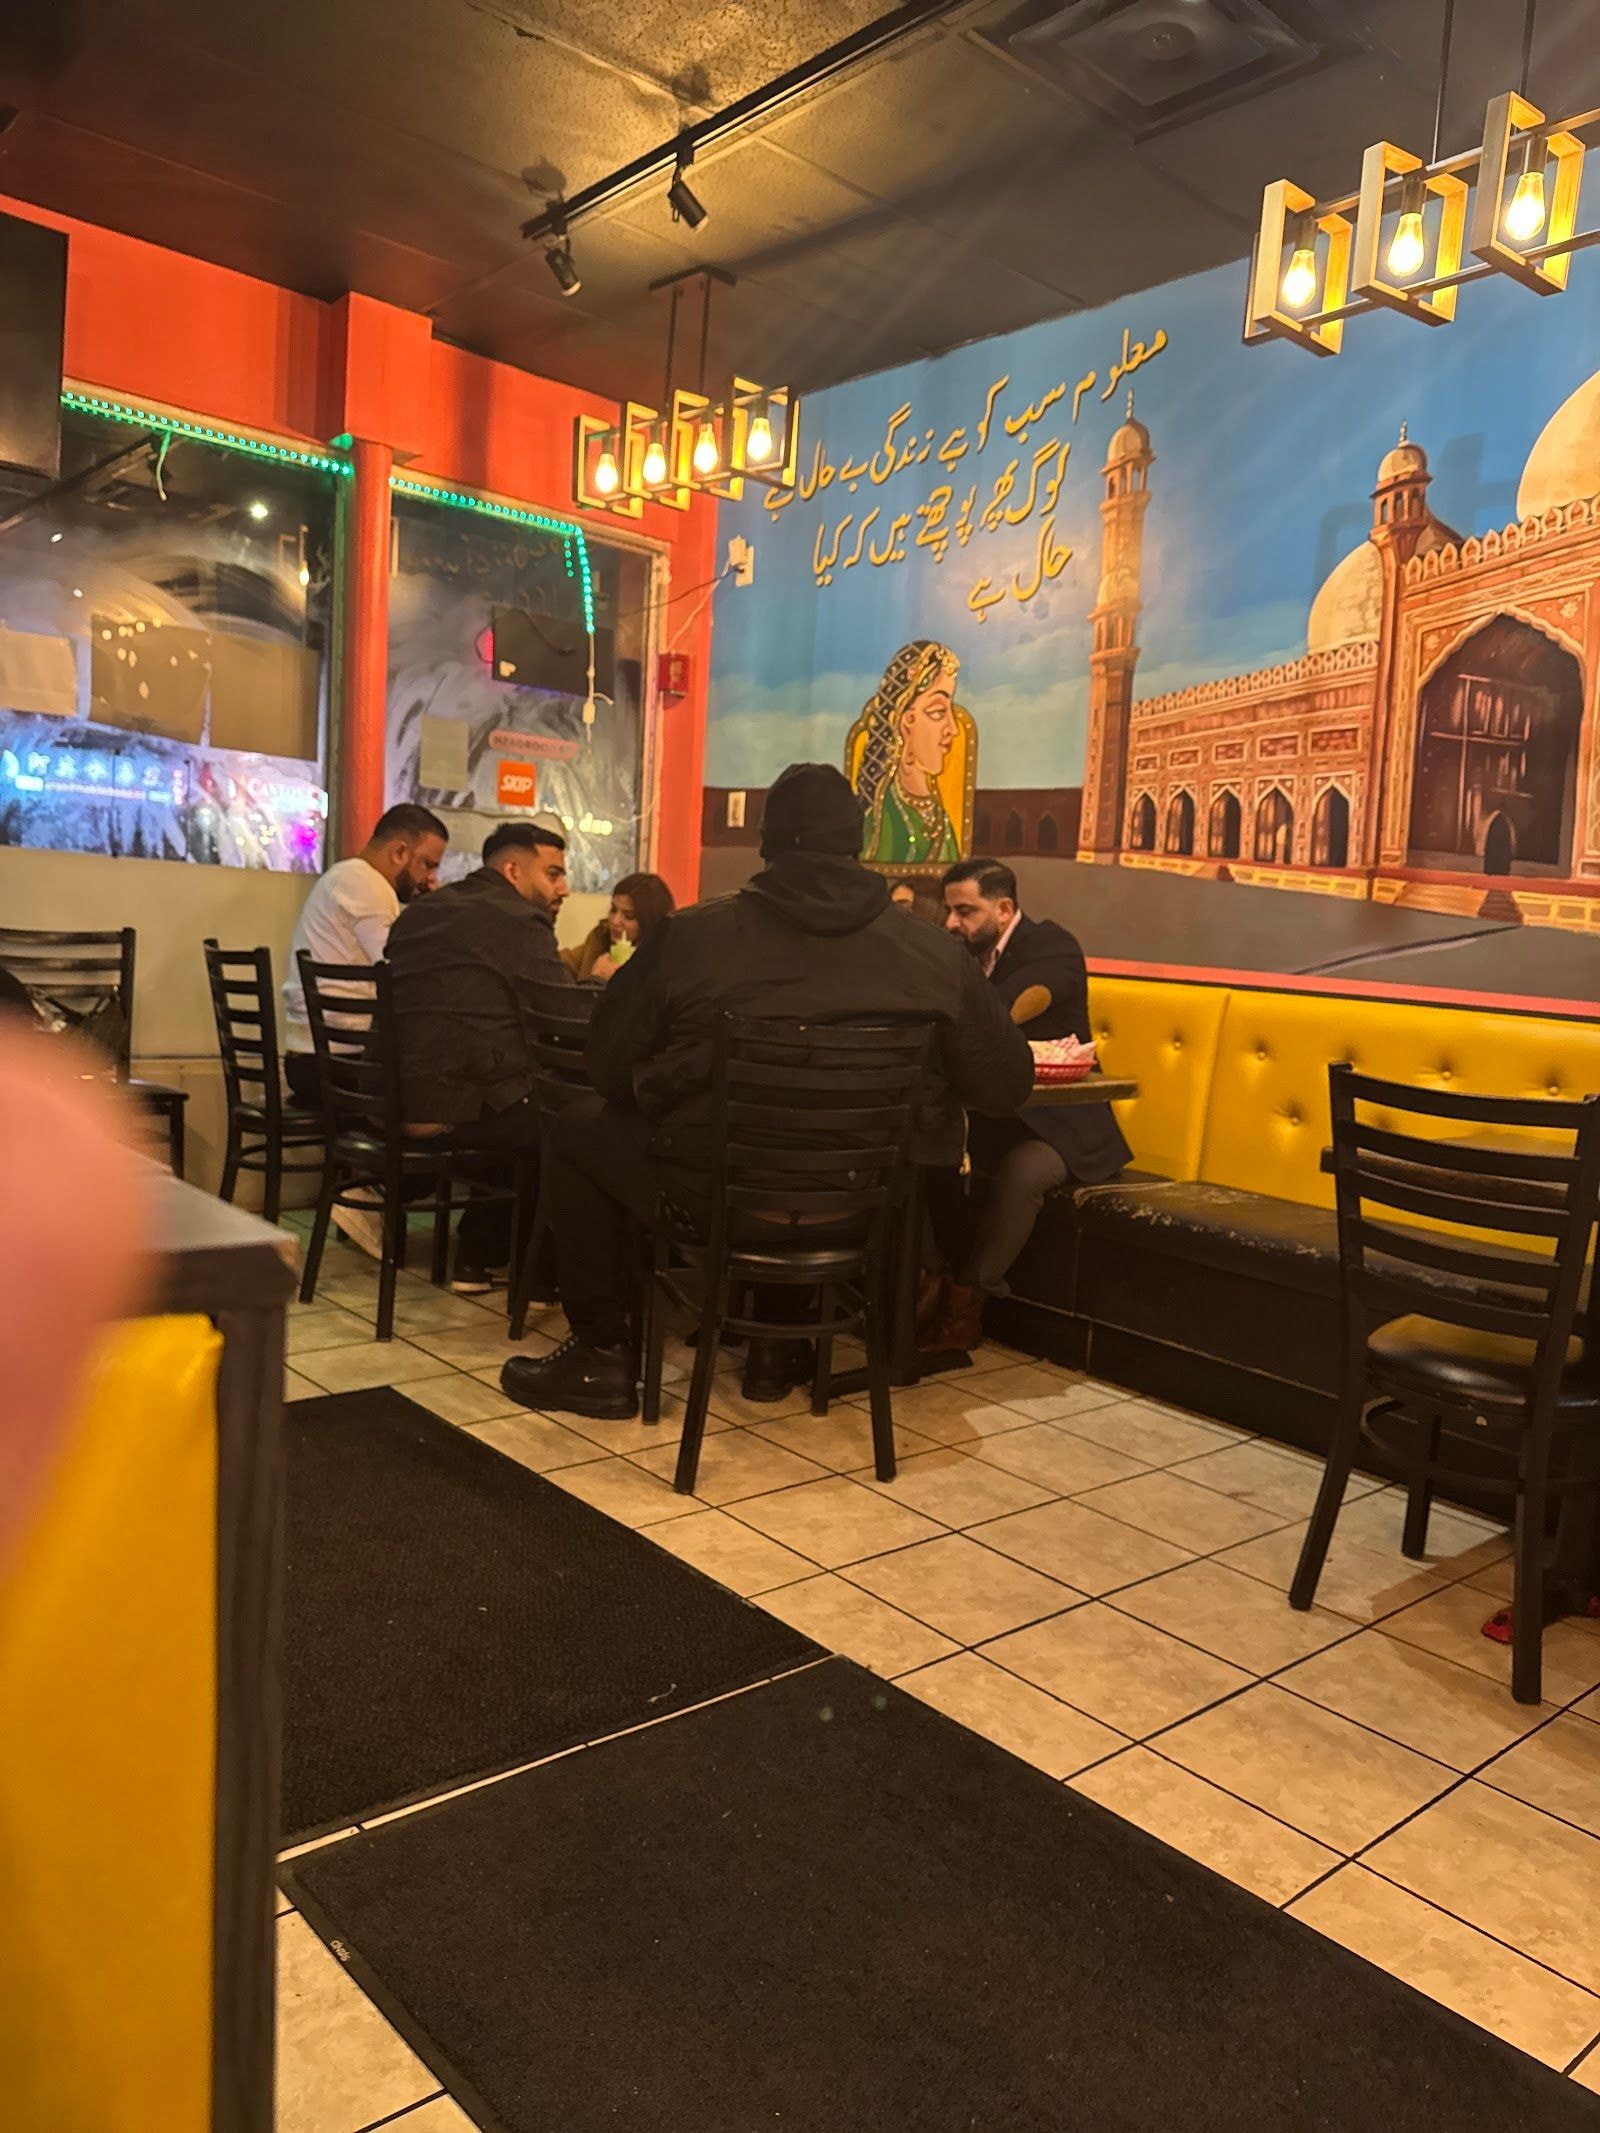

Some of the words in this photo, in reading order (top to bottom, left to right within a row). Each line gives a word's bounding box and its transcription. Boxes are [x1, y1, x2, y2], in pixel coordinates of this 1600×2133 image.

[1072, 327, 1168, 424] معلوم
[870, 402, 935, 485] زندگی
[938, 427, 969, 473] ہے
[977, 375, 1009, 454] کو
[1005, 382, 1066, 444] سب
[799, 440, 836, 501] حال
[979, 458, 1020, 533] پھر
[1004, 437, 1071, 525] لوگ
[813, 513, 853, 587] کیا
[843, 506, 881, 569] کہ
[869, 513, 912, 566] ہیں
[915, 484, 977, 563] پوچھتے
[1011, 515, 1073, 602] حال
[967, 576, 1007, 624] ہے
[500, 774, 533, 794] SKIP
